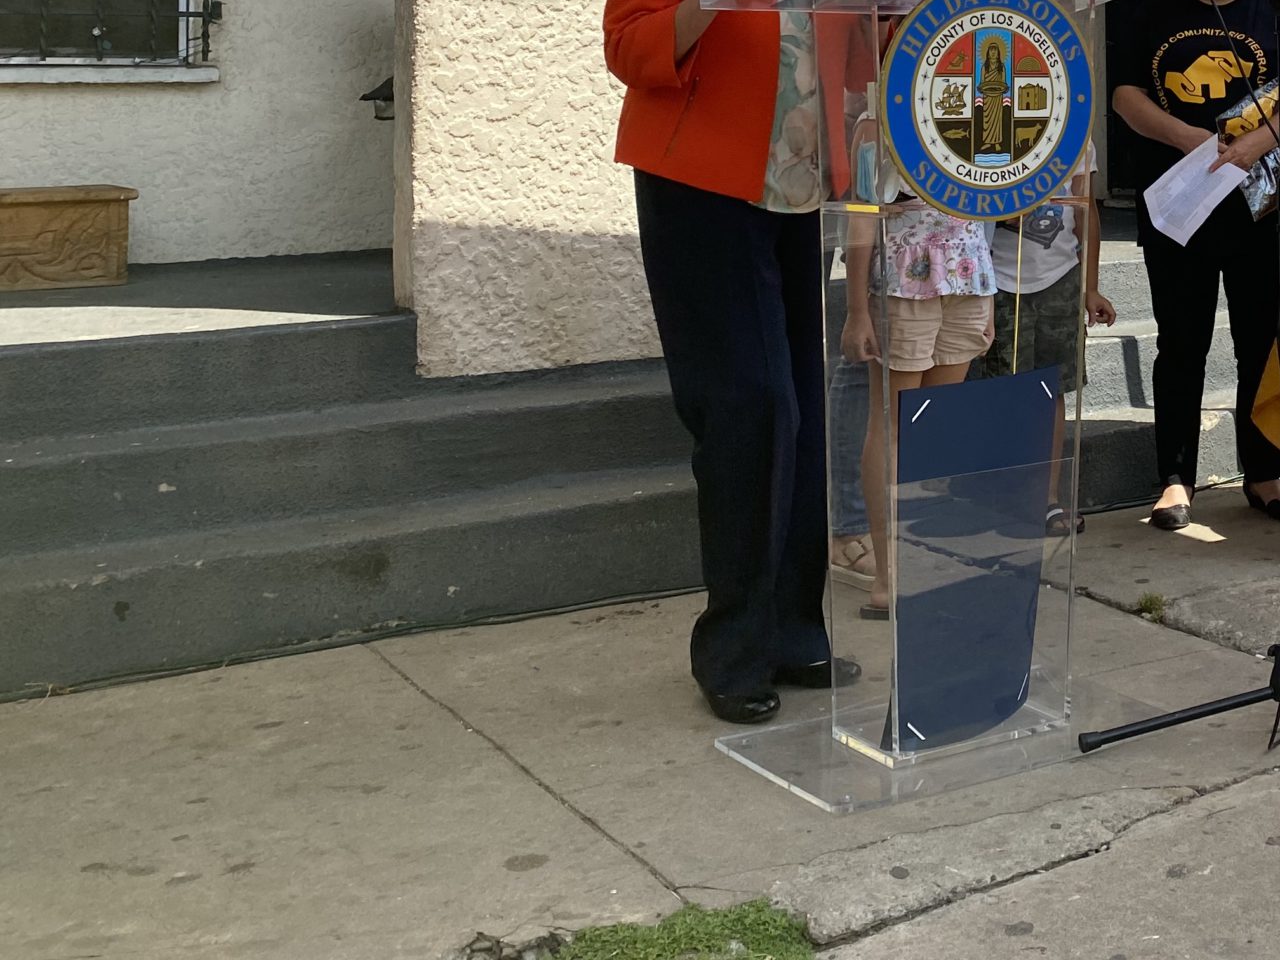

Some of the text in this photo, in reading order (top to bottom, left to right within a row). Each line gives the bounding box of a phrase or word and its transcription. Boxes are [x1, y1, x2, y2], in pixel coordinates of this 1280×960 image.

[926, 12, 1060, 69] COUNTY OF LOS ANGELES
[1244, 36, 1268, 74] TIERRA
[912, 155, 1069, 215] SUPERVISOR
[956, 162, 1031, 184] CALIFORNIA
